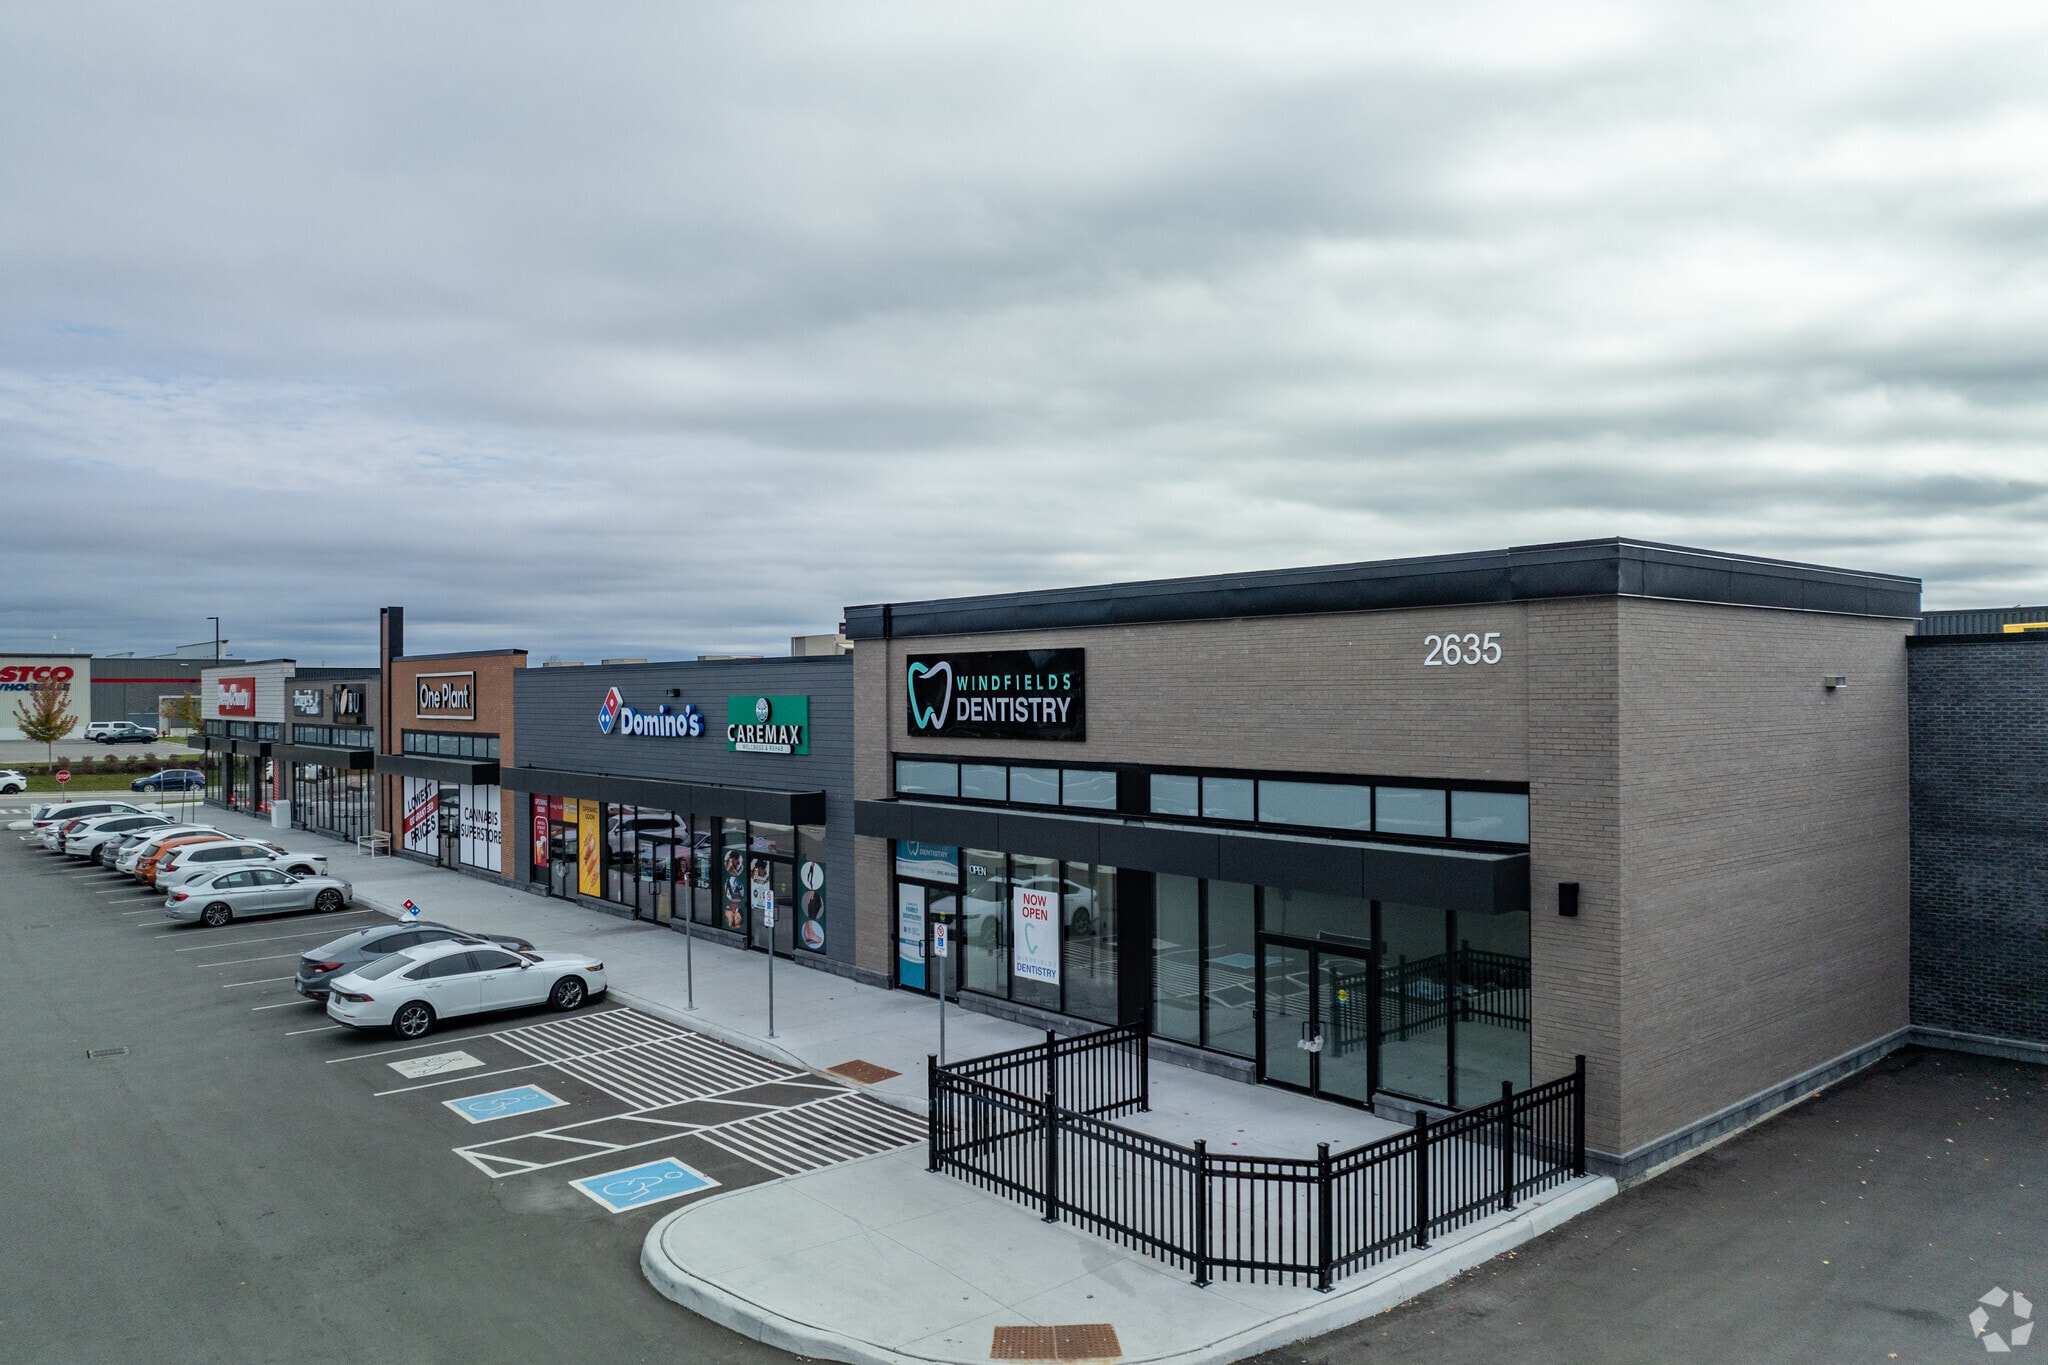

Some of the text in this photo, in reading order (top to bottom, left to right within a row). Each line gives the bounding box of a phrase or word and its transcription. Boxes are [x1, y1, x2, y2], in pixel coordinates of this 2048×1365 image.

[1424, 632, 1501, 666] 2635
[0, 666, 74, 682] STCO
[956, 673, 1071, 691] WINDFIELDS
[420, 683, 469, 708] One Plant
[956, 697, 1071, 723] DENTISTRY
[621, 704, 702, 736] Domino's
[727, 724, 799, 744] CAREMAX
[408, 783, 432, 813] LOWEST
[465, 807, 498, 825] CANNABIS
[410, 815, 436, 846] PRICES
[461, 824, 501, 845] SUPERSTORE
[919, 848, 948, 859] DENTISTRY
[969, 864, 987, 876] OPEN
[1023, 893, 1047, 907] NOW
[1022, 906, 1048, 921] OPEN
[1017, 954, 1057, 967] WINDFIELDS
[1016, 962, 1057, 979] DENTISTRY
